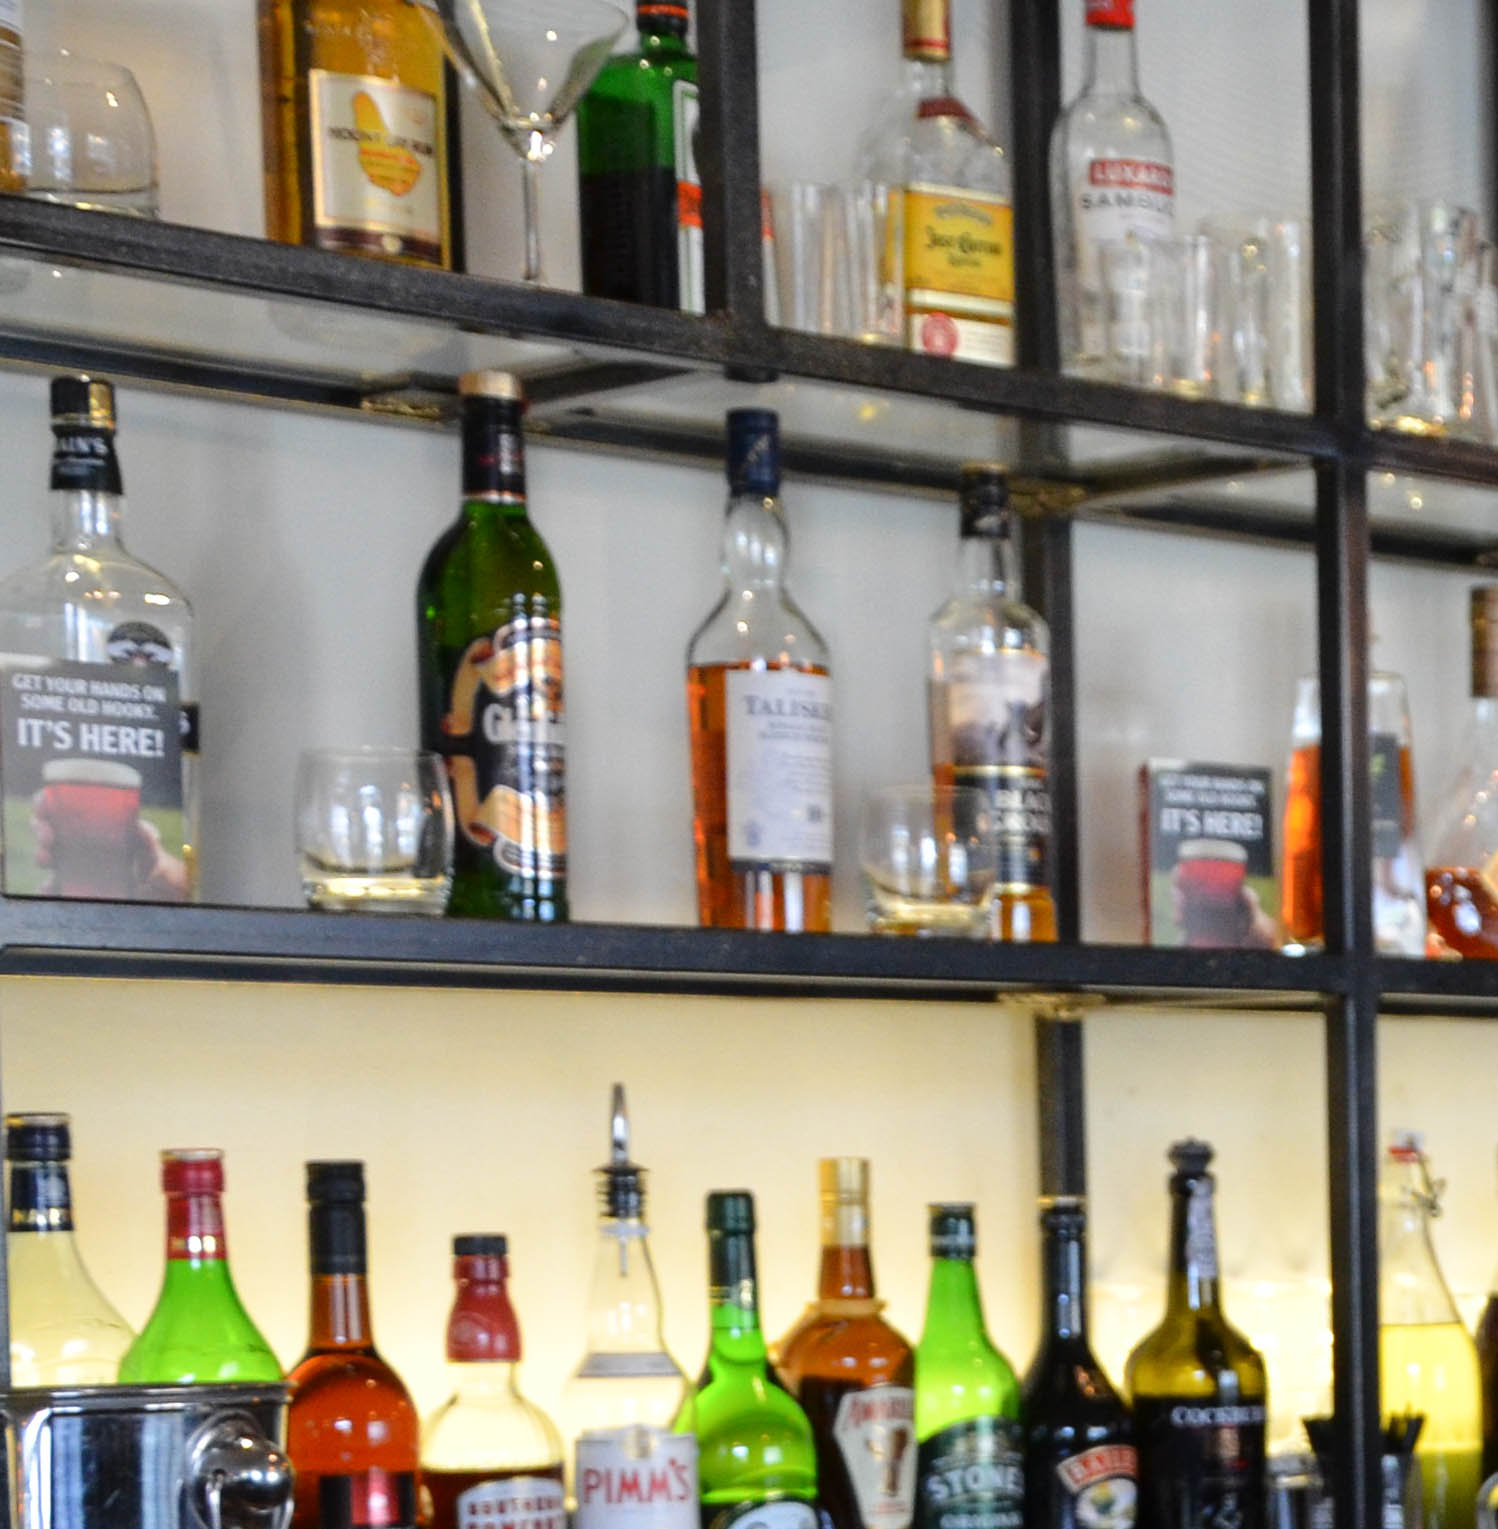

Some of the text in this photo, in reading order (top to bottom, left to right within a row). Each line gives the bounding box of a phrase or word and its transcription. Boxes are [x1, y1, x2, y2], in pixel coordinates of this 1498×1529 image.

[12, 673, 167, 703] GET YOUR HANDS ON
[20, 693, 65, 712] SOME
[66, 697, 99, 715] OLD
[17, 717, 74, 750] IT'S
[79, 722, 166, 758] HERE!
[1161, 808, 1263, 841] IT'S HERE!
[582, 1457, 691, 1504] PIMM'S
